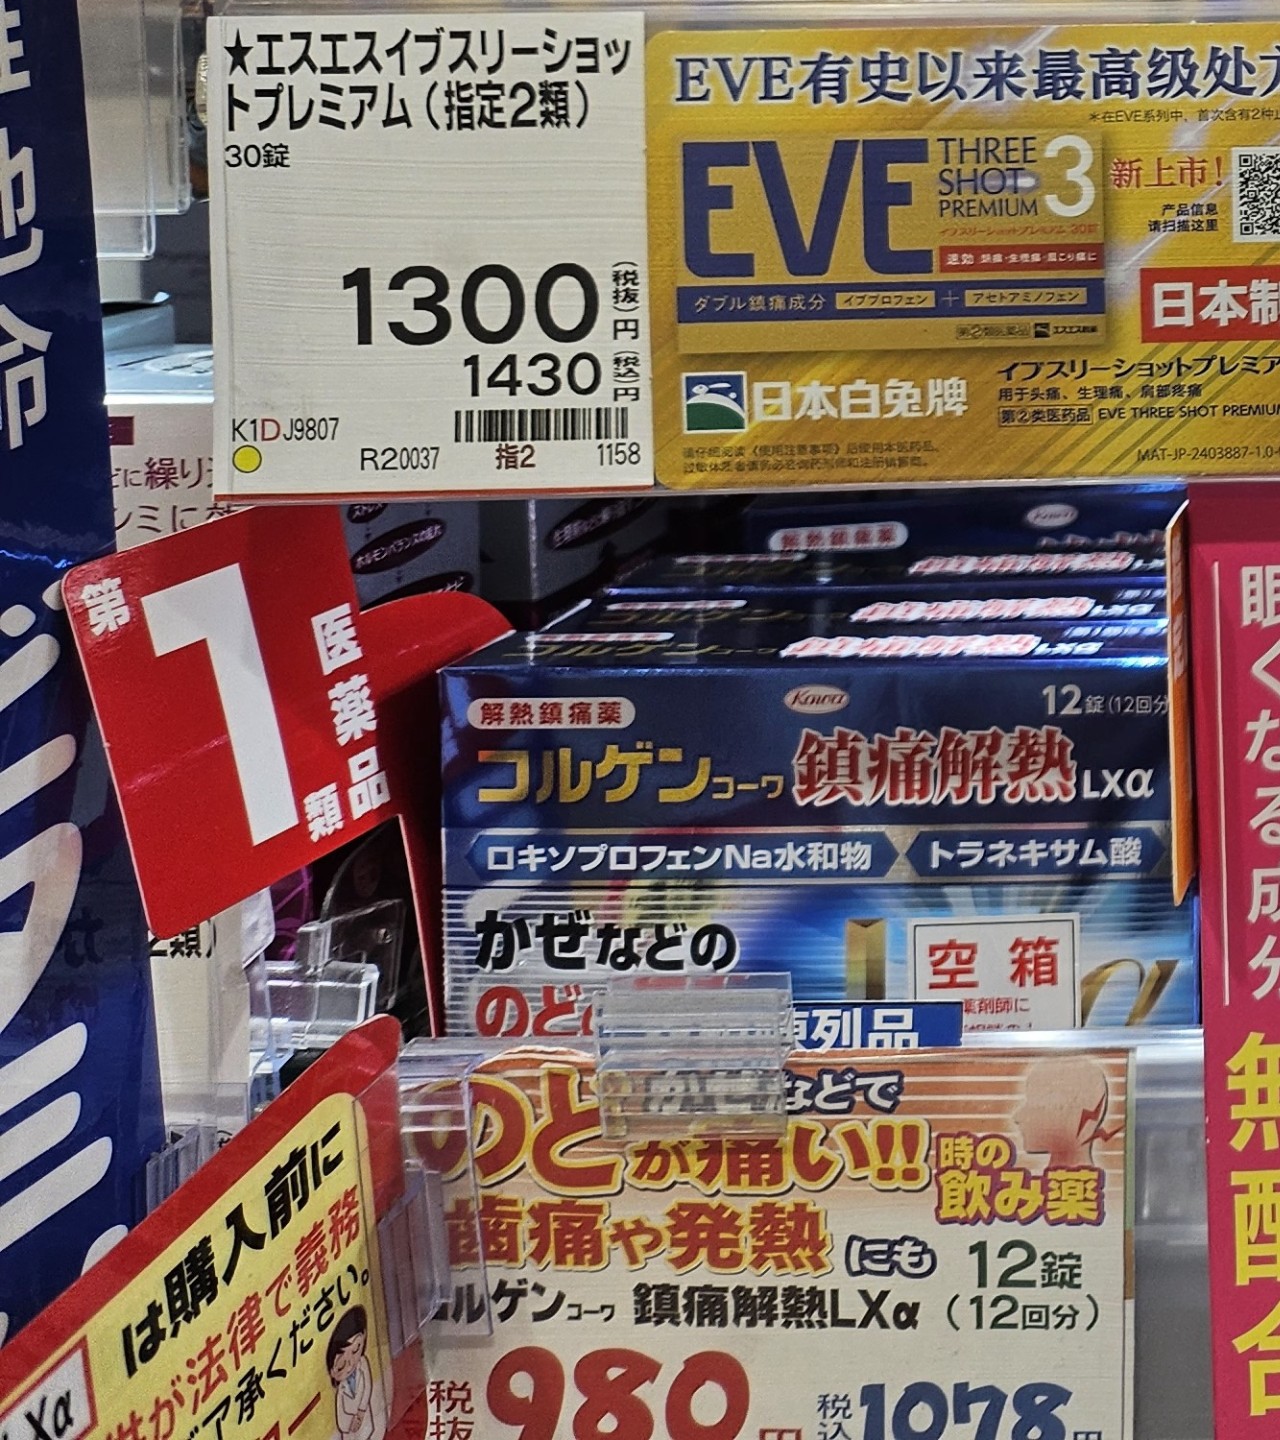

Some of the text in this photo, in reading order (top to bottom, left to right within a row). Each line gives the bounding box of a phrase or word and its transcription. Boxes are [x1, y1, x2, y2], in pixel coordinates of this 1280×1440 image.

[225, 144, 291, 169] 30錠
[342, 262, 599, 346] 1300
[463, 351, 602, 397] 1430
[753, 377, 968, 423] 日本白兔牌
[79, 576, 131, 637] 第
[142, 562, 300, 847] 1
[310, 602, 391, 819] 医薬品
[480, 703, 622, 725] 解熱鎮痛薬
[1042, 685, 1104, 716] 12錠
[303, 782, 346, 843] 類
[486, 843, 872, 874] ロキソプロフェンNa水和物
[930, 837, 1143, 869] トラネキサム酸
[475, 910, 738, 971] かぜなどの
[967, 1240, 1083, 1290] 12錠
